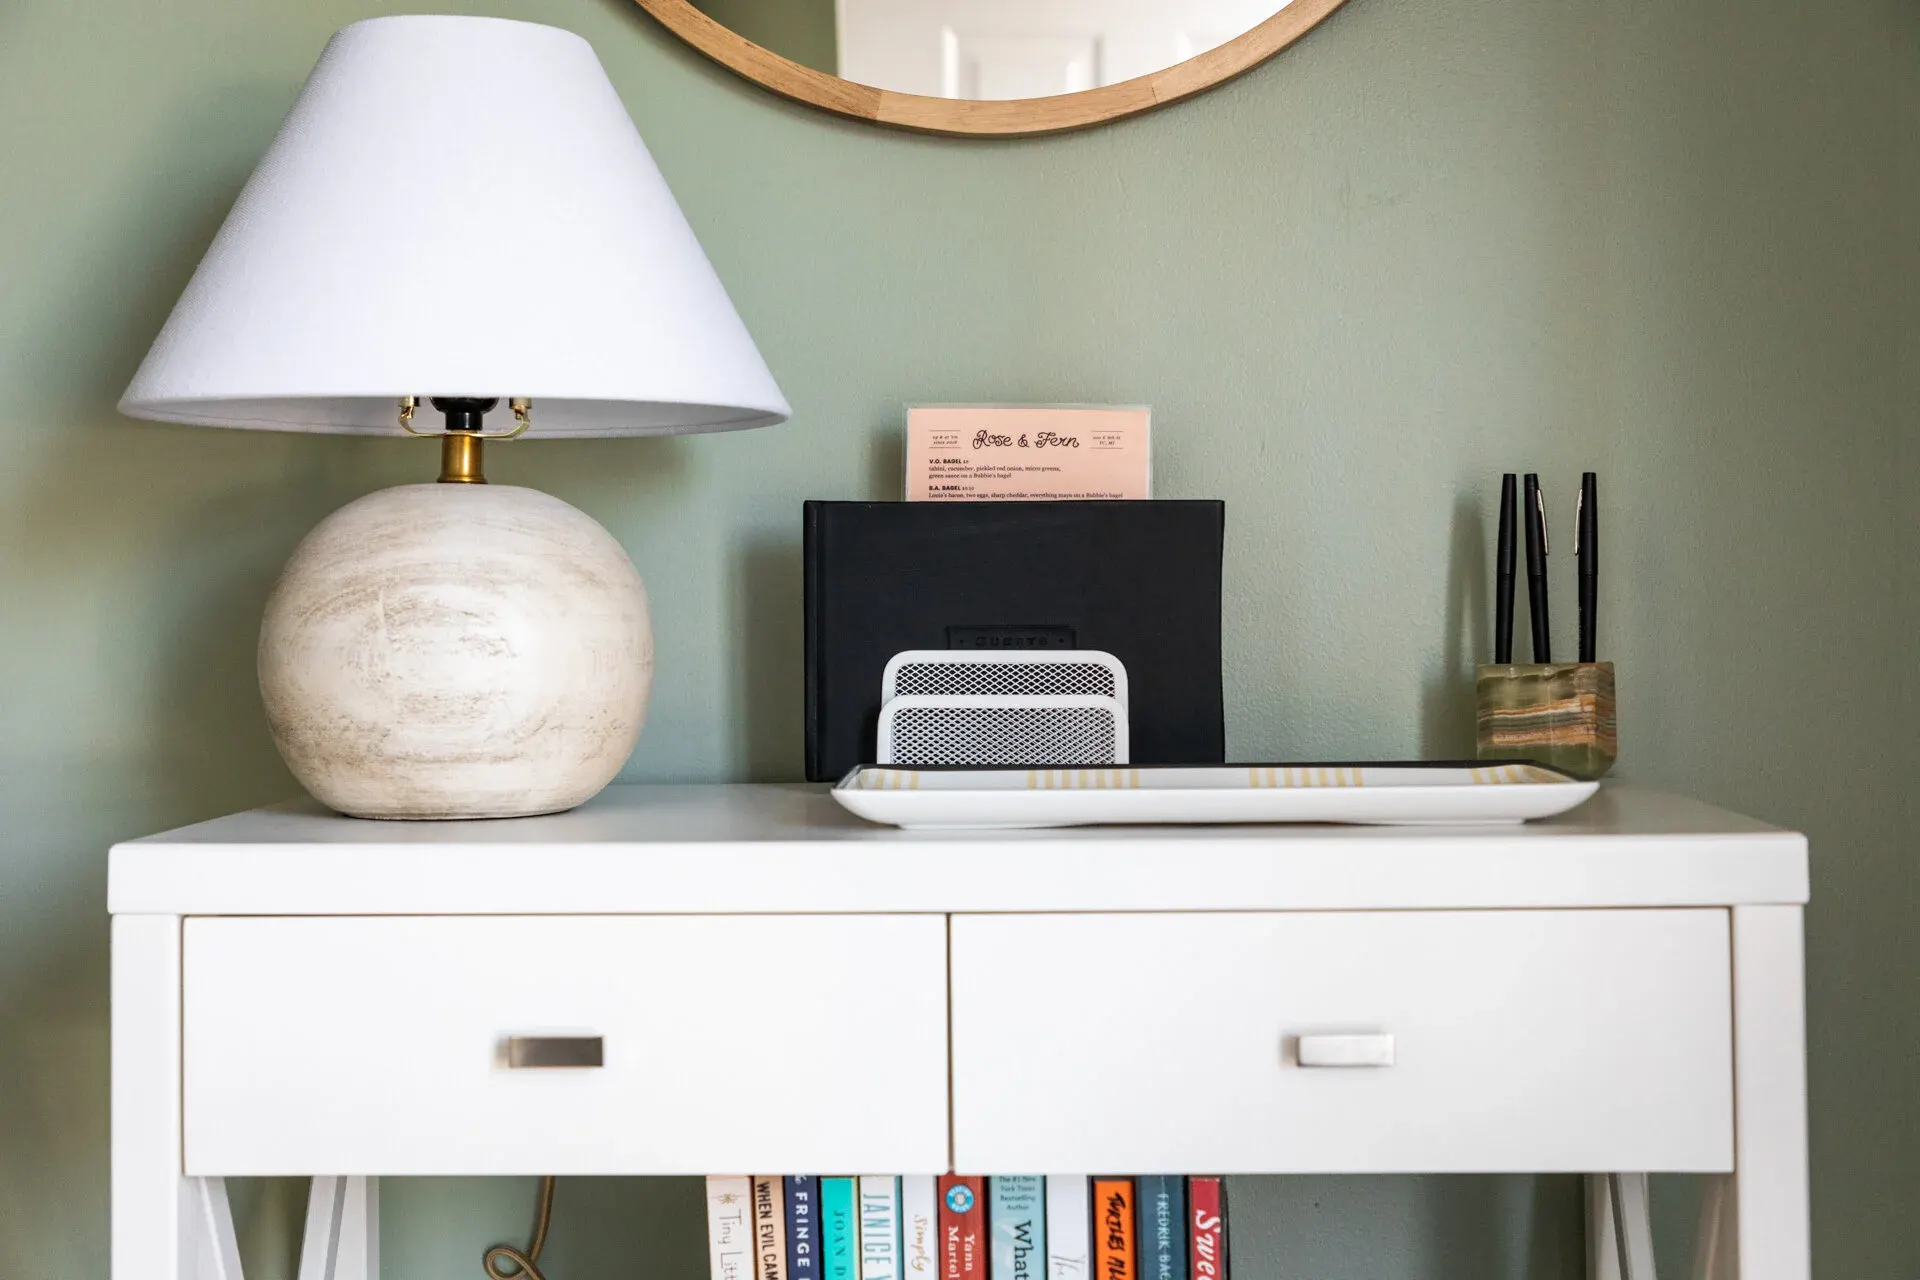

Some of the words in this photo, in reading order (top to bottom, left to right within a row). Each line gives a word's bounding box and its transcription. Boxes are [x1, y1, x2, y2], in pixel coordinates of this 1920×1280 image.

[973, 429, 1012, 450] Rose
[1018, 434, 1029, 448] &
[1034, 432, 1080, 448] Fern
[757, 1181, 772, 1219] WHEN
[1000, 1194, 1036, 1202] Bestselling
[718, 1208, 742, 1245] Tiny
[760, 1224, 775, 1251] EVIL
[795, 1192, 810, 1267] FRINGE
[834, 1210, 846, 1256] JOAN
[864, 1193, 892, 1264] JANICE
[911, 1214, 932, 1272] Simply
[1106, 1192, 1127, 1252] TURTLES
[1156, 1193, 1170, 1250] FREDRIK
[834, 1266, 847, 1280] D
[948, 1226, 960, 1278] Martel
[964, 1233, 976, 1271] Yann
[1014, 1220, 1034, 1280] What
